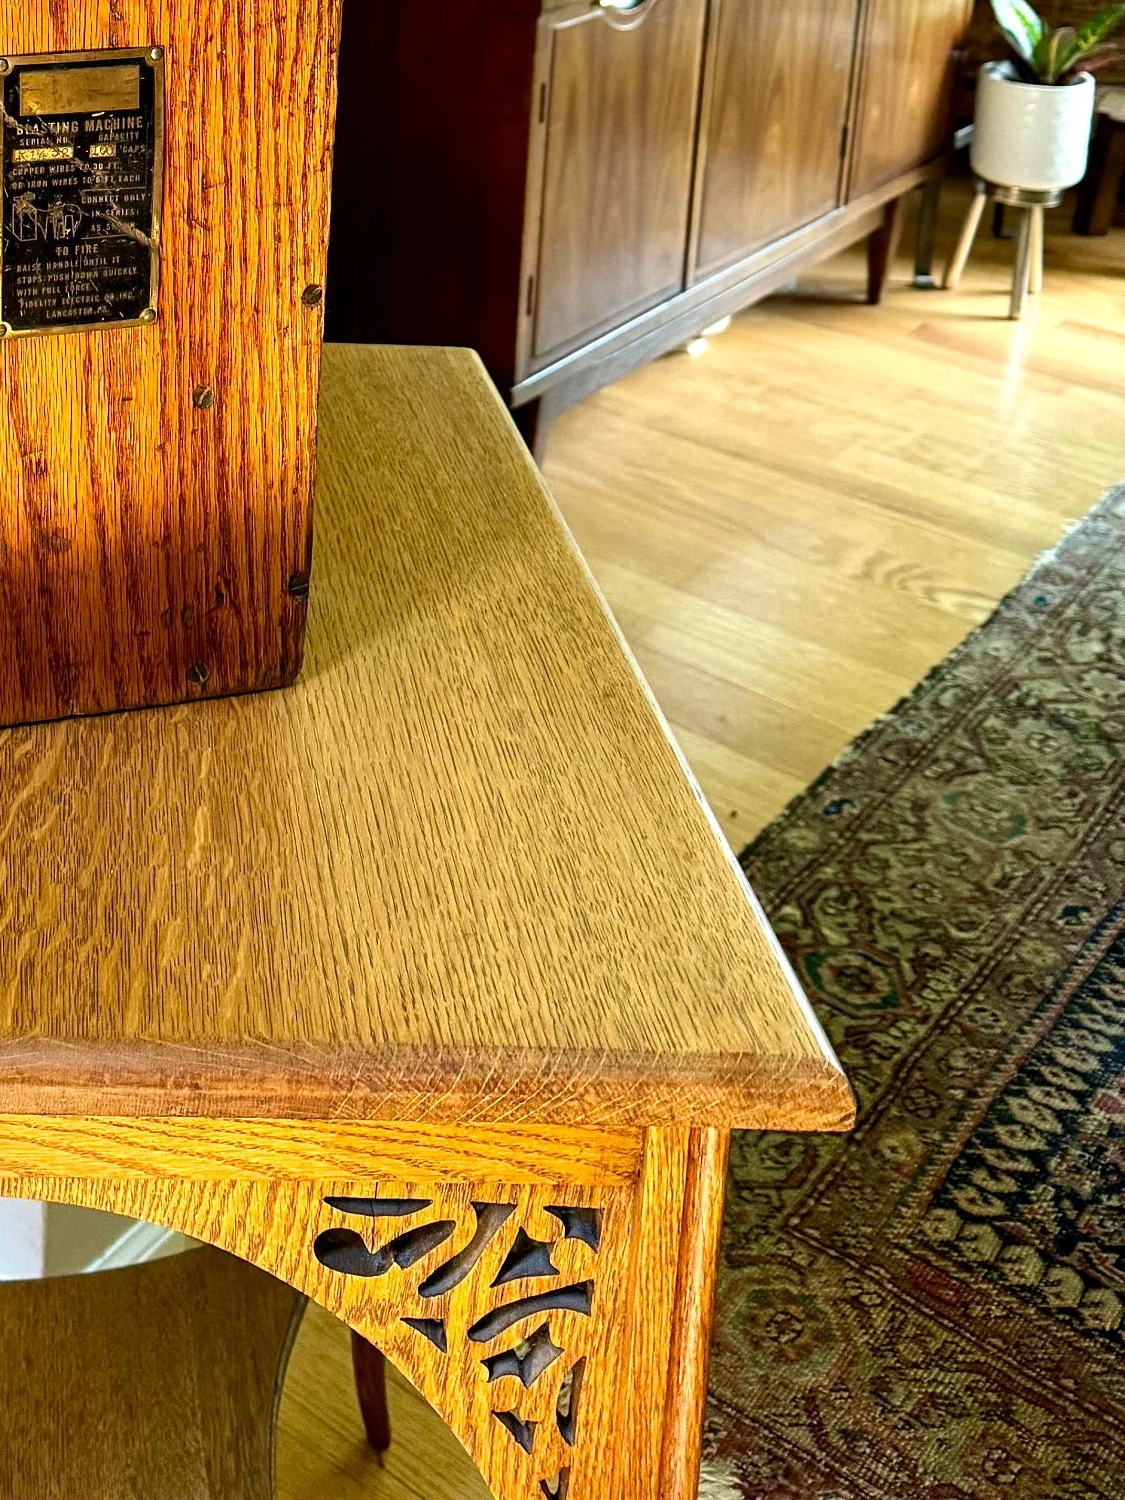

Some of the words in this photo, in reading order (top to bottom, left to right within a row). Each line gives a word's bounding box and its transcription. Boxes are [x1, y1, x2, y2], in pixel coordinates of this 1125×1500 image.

[16, 121, 79, 136] BLASTING
[85, 116, 143, 132] MACHINE
[98, 131, 140, 142] CAPACITY
[12, 166, 46, 176] COPPER
[49, 164, 76, 174] WIRES
[27, 179, 48, 189] IRON
[52, 177, 78, 188] WIRES
[118, 173, 140, 183] EACH
[81, 194, 119, 205] CONNECT
[123, 192, 145, 202] ONLY
[91, 210, 101, 218] IN
[55, 246, 69, 256] TO
[75, 243, 99, 255] FIRE
[16, 263, 41, 273] RAISE
[46, 260, 79, 271] HANDLE
[83, 257, 107, 266] UNTIL
[112, 255, 120, 264] IT
[75, 270, 99, 280] DOWN
[103, 266, 137, 277] QUICKLY
[16, 287, 38, 297] WITH
[42, 285, 61, 296] FULL
[61, 295, 100, 306] ELECTRIC
